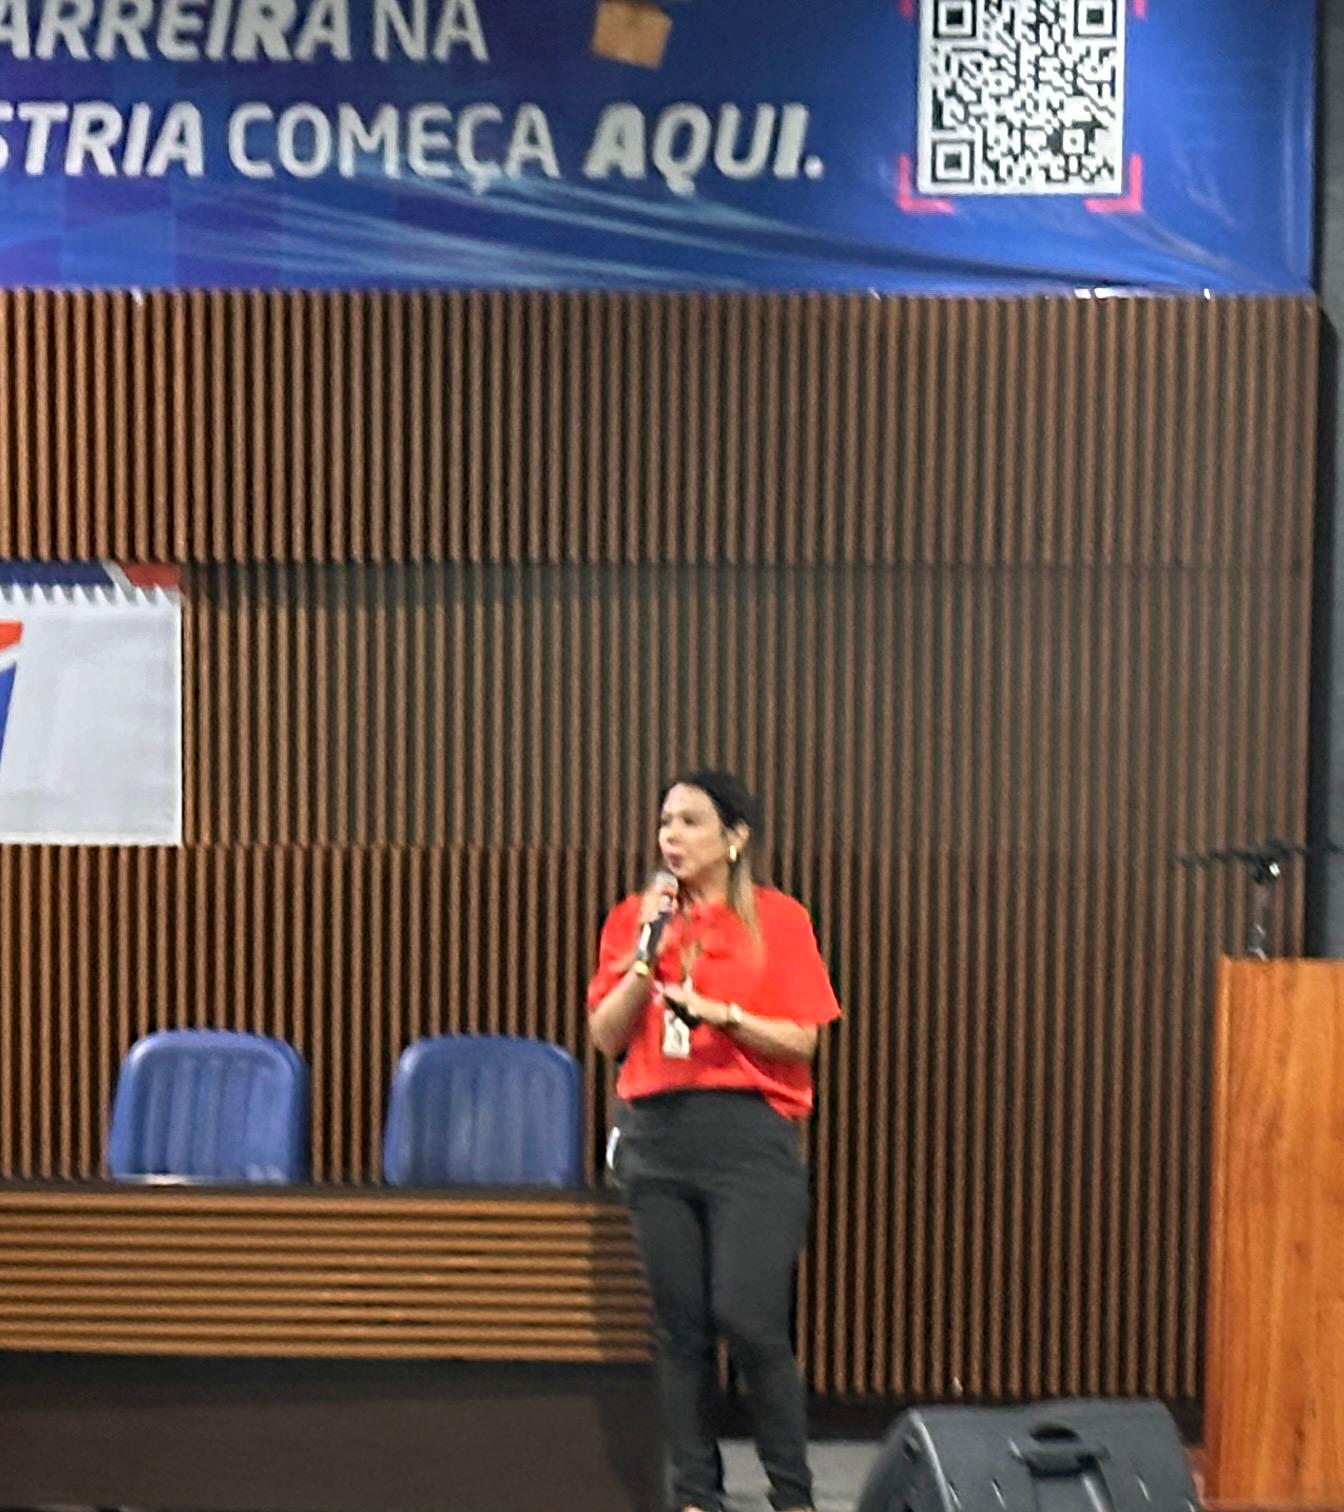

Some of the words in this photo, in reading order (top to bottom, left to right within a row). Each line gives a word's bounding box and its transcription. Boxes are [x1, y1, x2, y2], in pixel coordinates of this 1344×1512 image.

[372, 0, 490, 63] NA
[227, 102, 561, 195] COMEÇA
[582, 102, 825, 195] AQUI.
